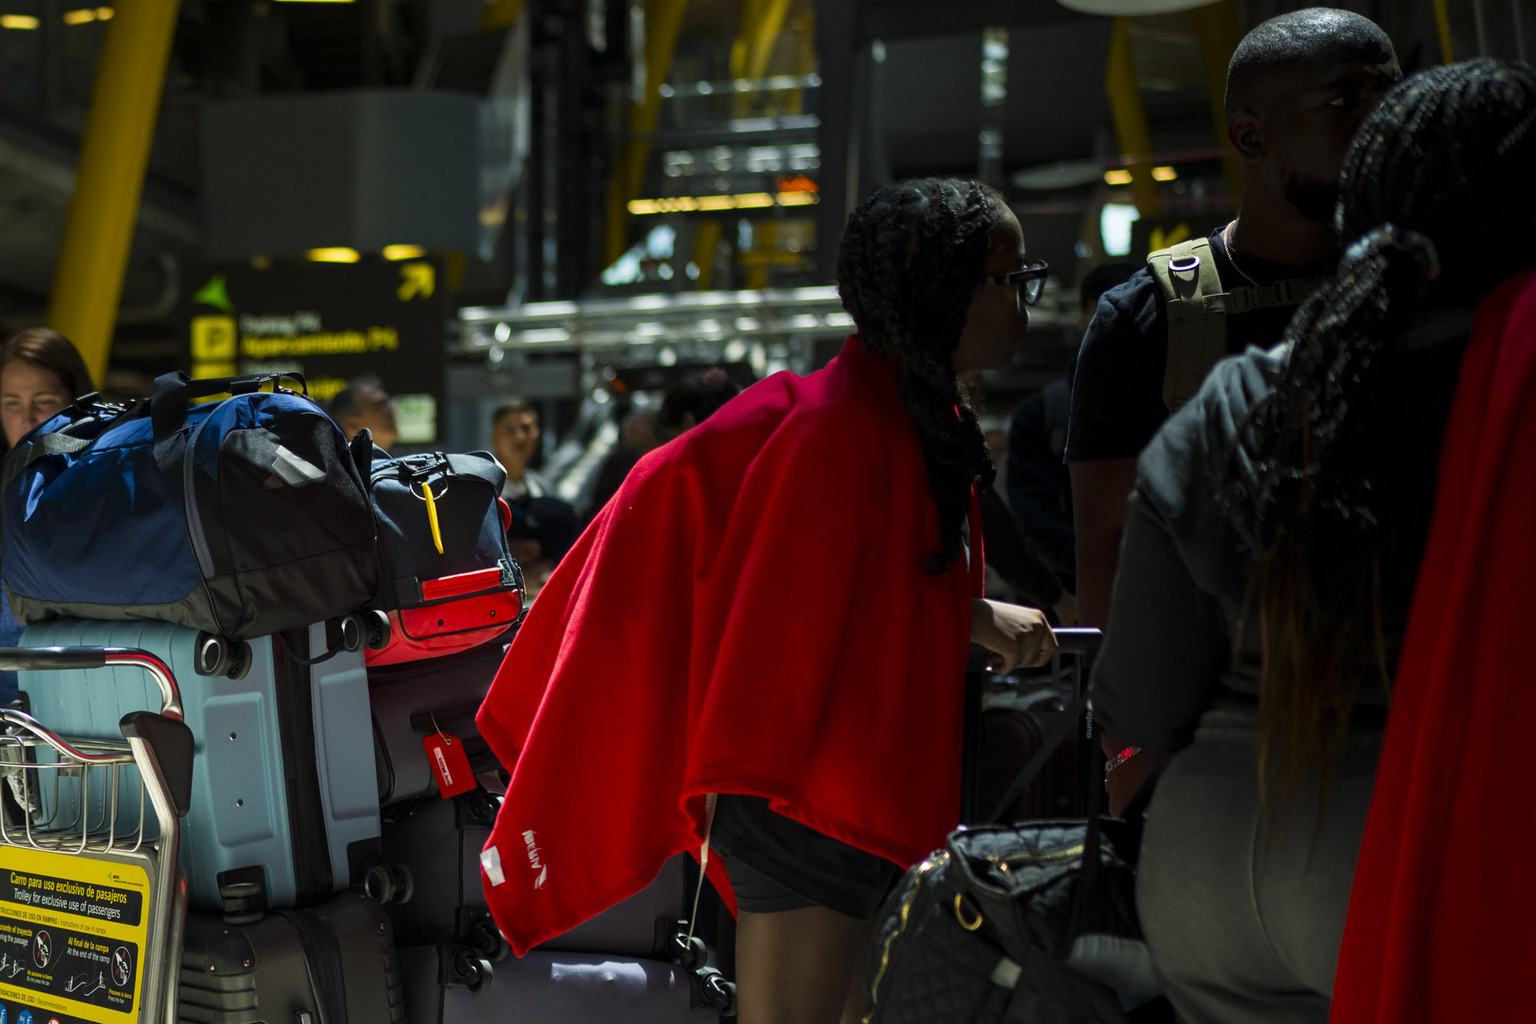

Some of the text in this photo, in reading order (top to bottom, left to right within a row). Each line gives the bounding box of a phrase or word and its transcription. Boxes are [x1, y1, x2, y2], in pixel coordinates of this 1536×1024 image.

[10, 872, 127, 906] Carro para uso exclusivo de pasajeros
[13, 888, 121, 921] Trolley for exclusive use of passengers
[43, 916, 57, 924] RAMPAS
[12, 925, 16, 933] el
[17, 926, 32, 938] trayecto
[14, 937, 28, 947] passage
[68, 937, 109, 955] Al final de la rampa
[67, 947, 72, 955] At
[88, 951, 92, 959] of
[99, 955, 110, 965] ramp
[21, 993, 26, 1001] DE
